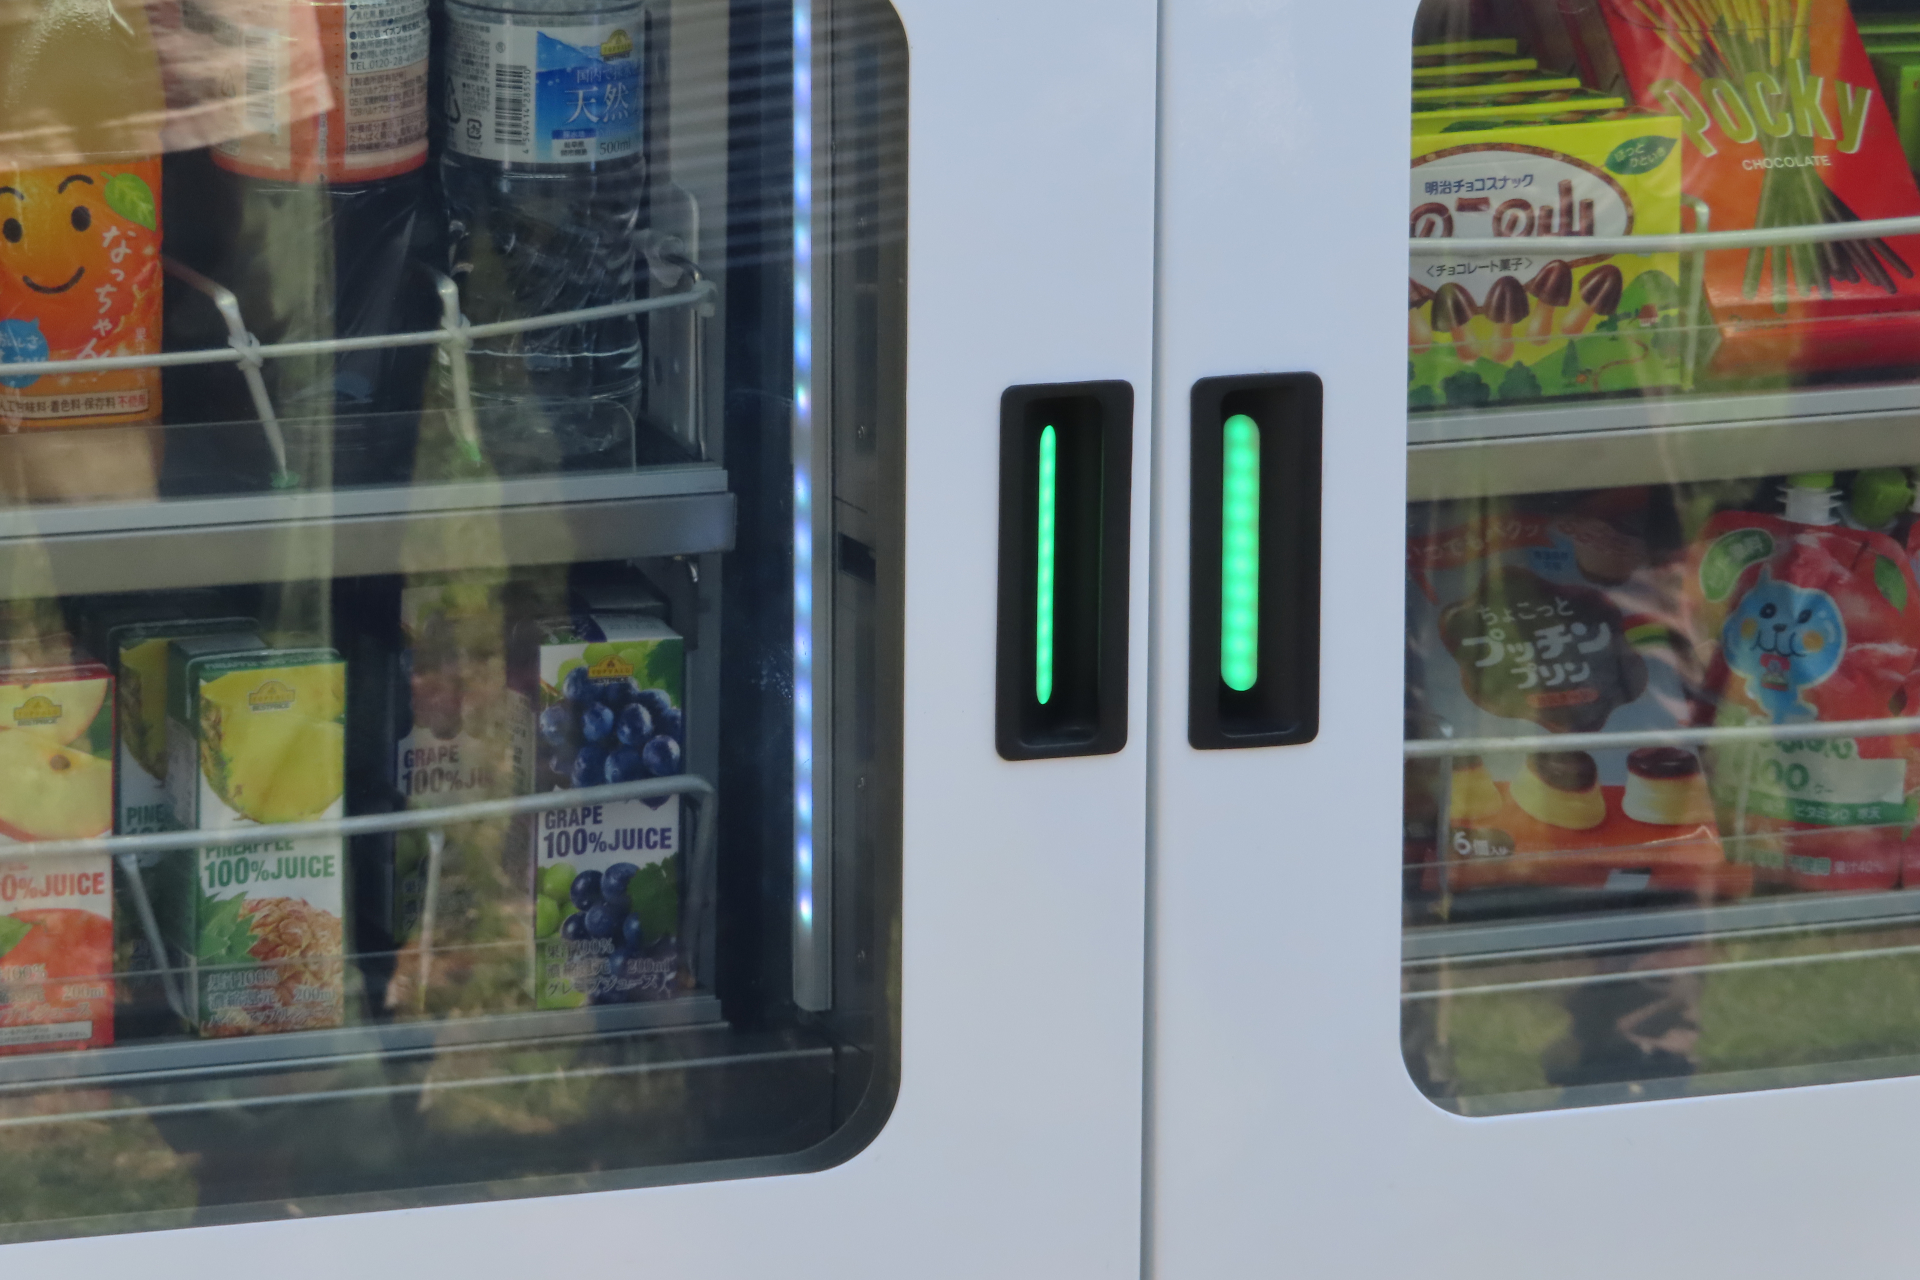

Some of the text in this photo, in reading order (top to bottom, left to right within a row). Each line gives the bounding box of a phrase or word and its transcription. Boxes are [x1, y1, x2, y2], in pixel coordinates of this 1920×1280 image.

[599, 138, 631, 156] 500ml
[1742, 155, 1832, 171] CHOCOLATE
[1424, 174, 1534, 196] 明治チョコスナック
[1478, 597, 1574, 625] ちょこっと
[1462, 622, 1612, 667] プッチン
[1510, 661, 1591, 689] プリン
[403, 744, 459, 769] GRAPE
[544, 805, 603, 830] GRAPE
